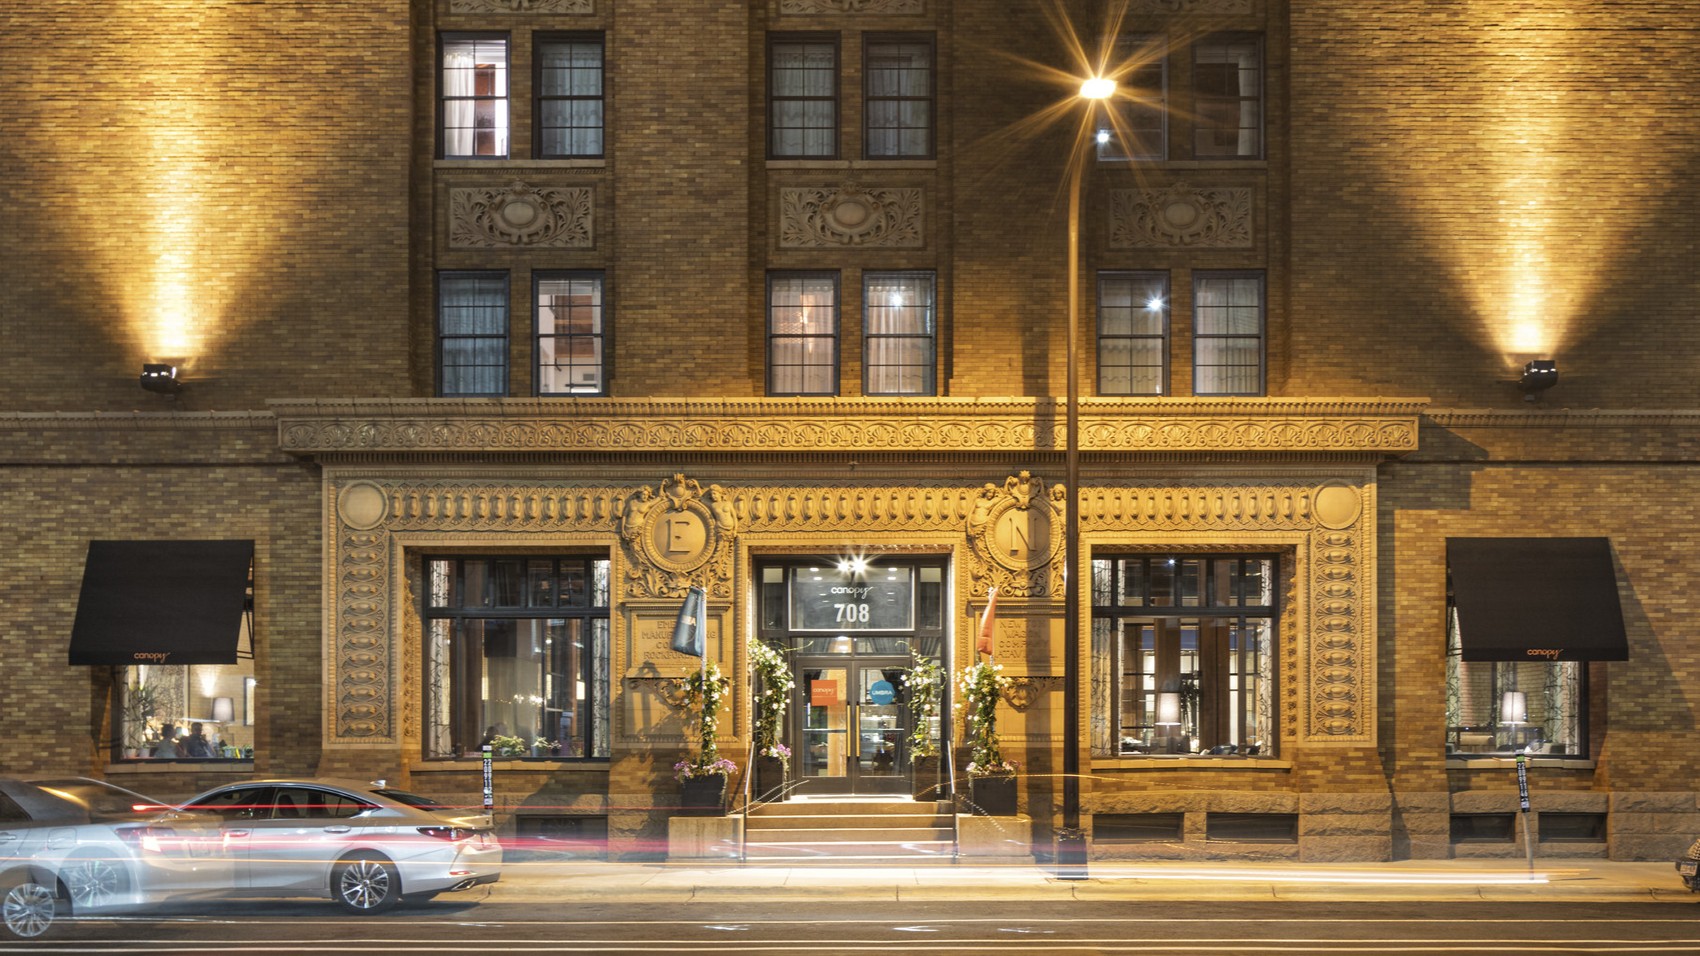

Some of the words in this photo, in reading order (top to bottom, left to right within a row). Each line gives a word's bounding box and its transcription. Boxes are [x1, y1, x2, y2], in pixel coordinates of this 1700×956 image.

[667, 519, 691, 553] E
[1009, 518, 1038, 551] N
[831, 586, 874, 599] canopy
[834, 603, 870, 622] 708
[134, 652, 171, 663] canopy
[1527, 649, 1564, 660] canopy
[813, 687, 834, 695] canopy
